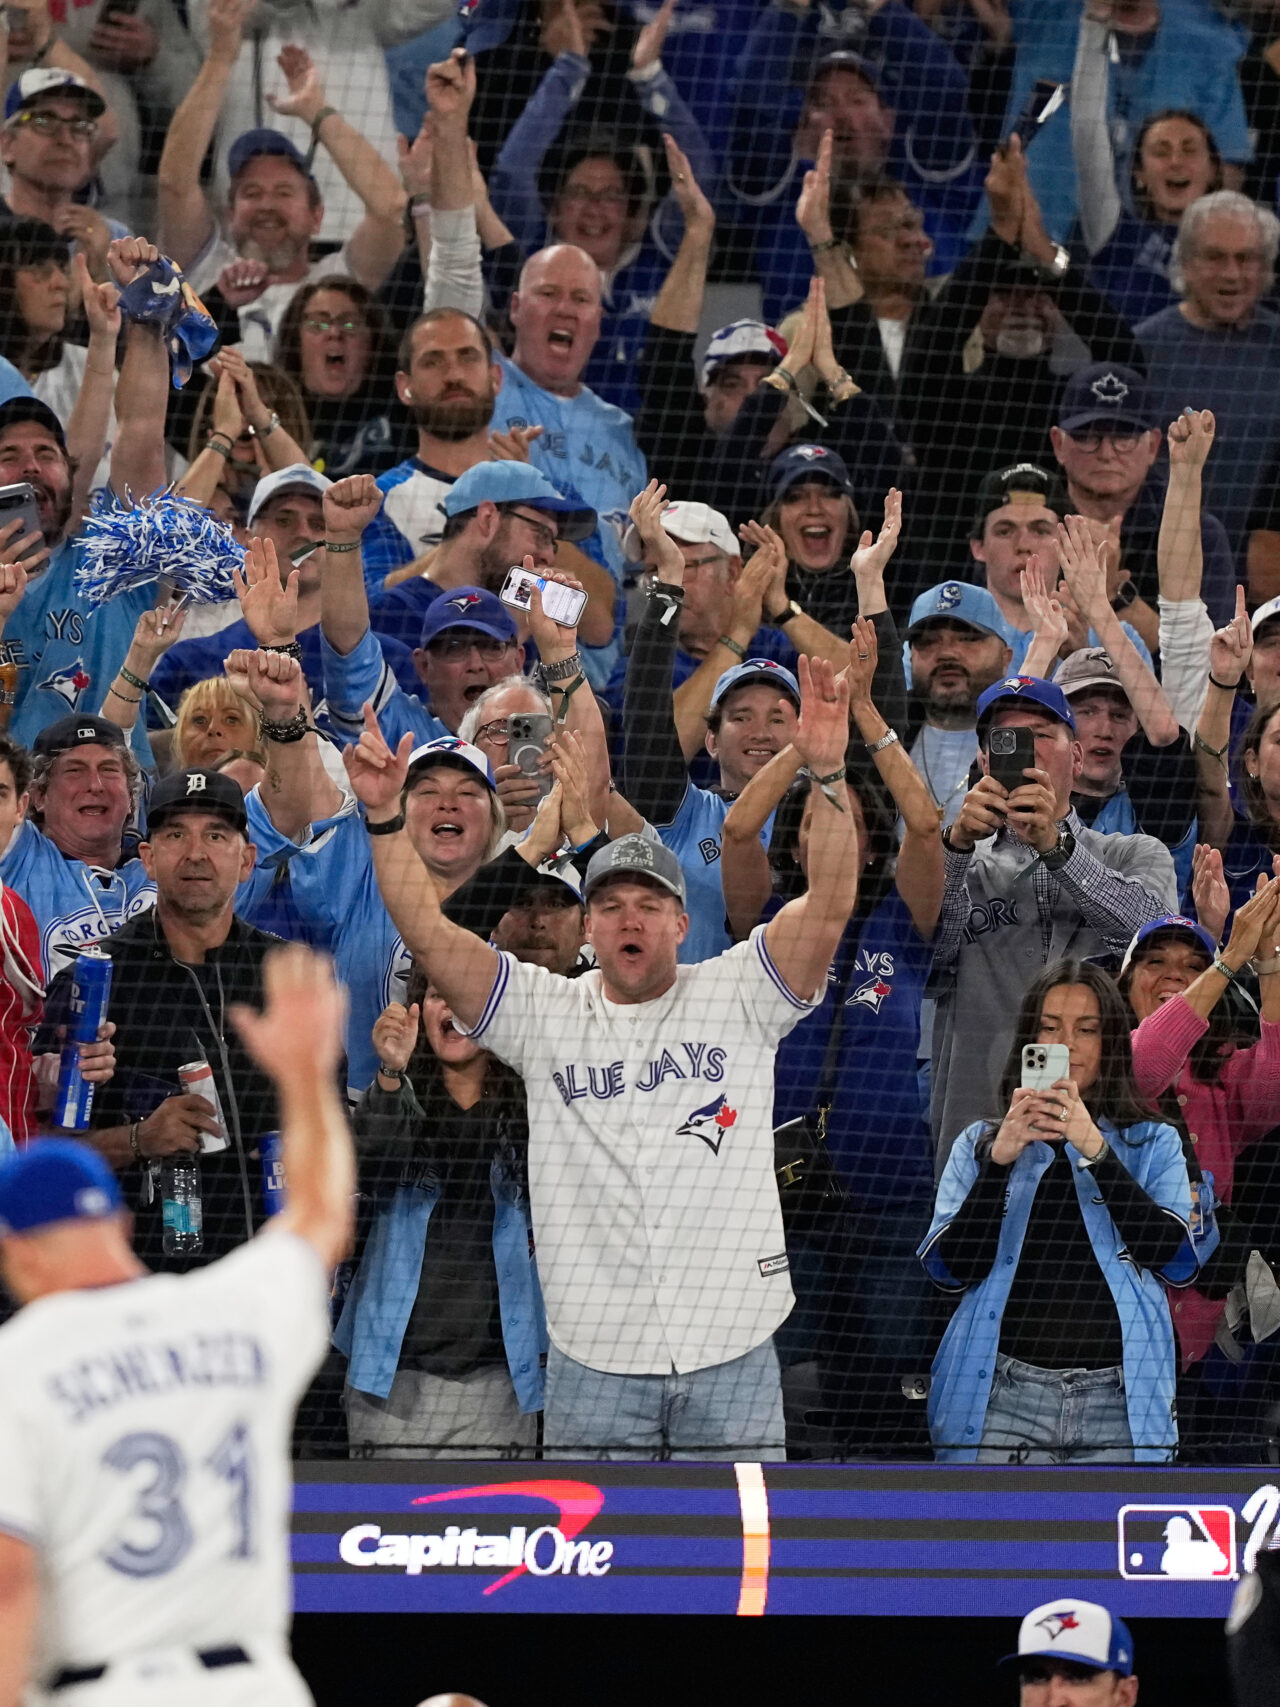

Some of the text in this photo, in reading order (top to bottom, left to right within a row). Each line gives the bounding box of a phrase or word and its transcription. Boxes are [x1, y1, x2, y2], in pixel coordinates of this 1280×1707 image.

[46, 608, 85, 645] YS
[854, 948, 894, 977] YS
[553, 1042, 728, 1106] BLUE JAYS
[914, 1378, 926, 1394] 3
[99, 1417, 252, 1579] 31
